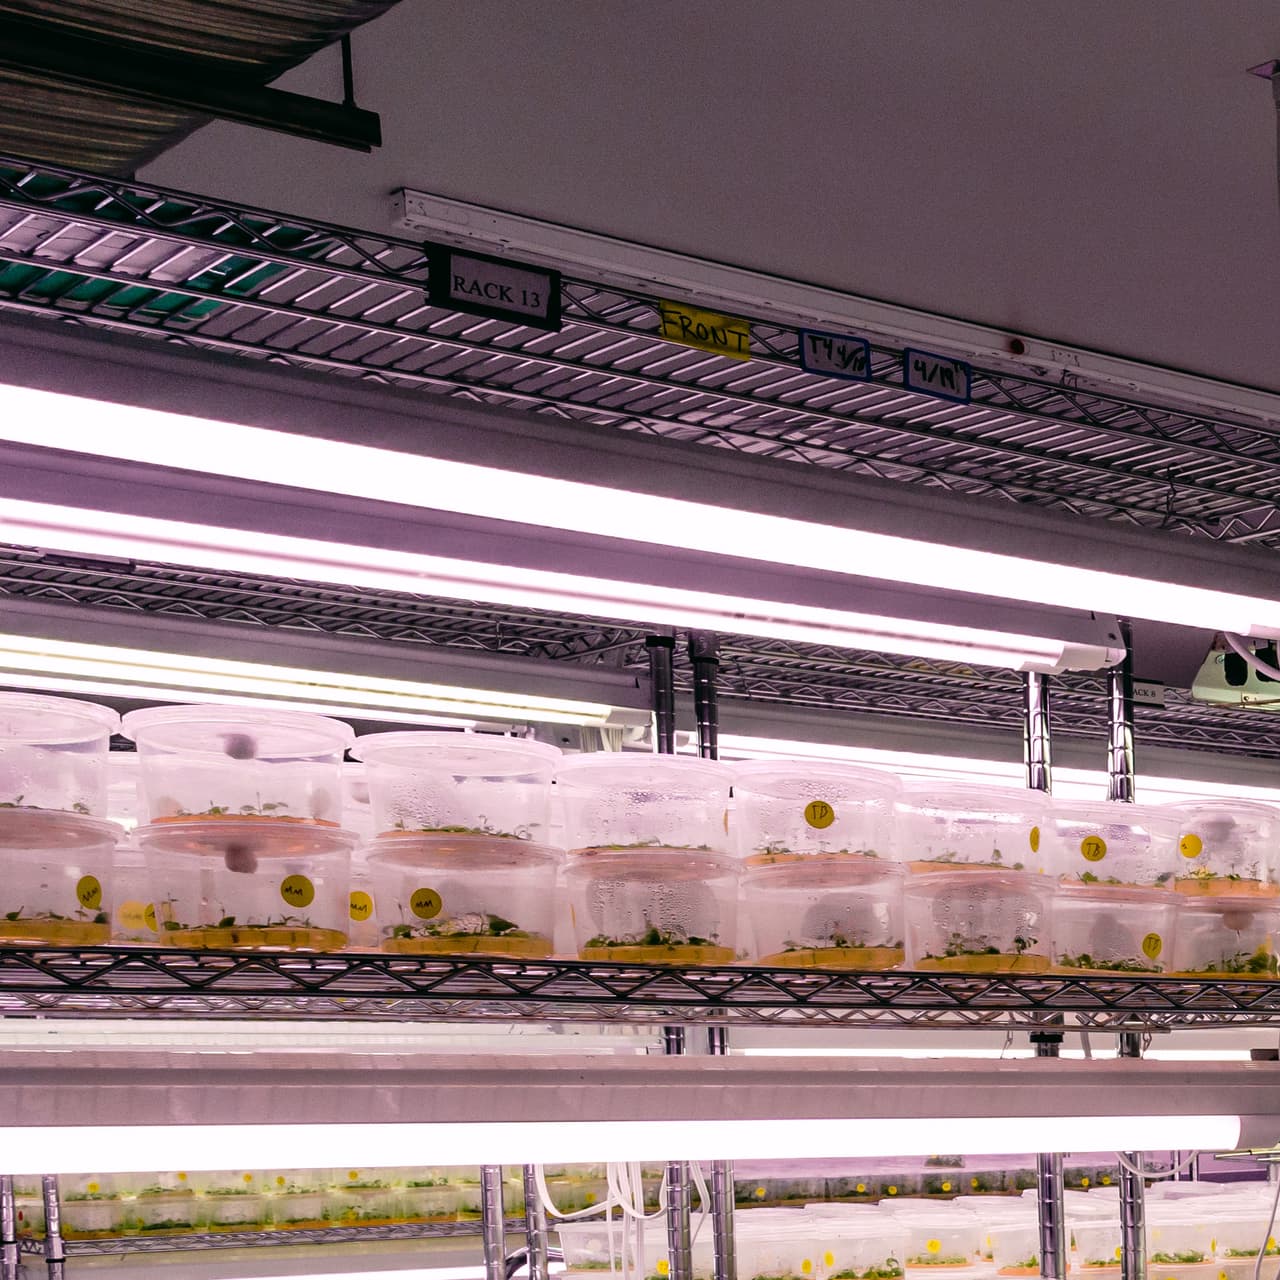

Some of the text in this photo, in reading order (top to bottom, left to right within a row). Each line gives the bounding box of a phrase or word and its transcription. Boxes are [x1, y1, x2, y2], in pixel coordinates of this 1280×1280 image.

[453, 275, 540, 308] RACK 13
[660, 310, 748, 352] FRONT
[414, 899, 434, 909] MM
